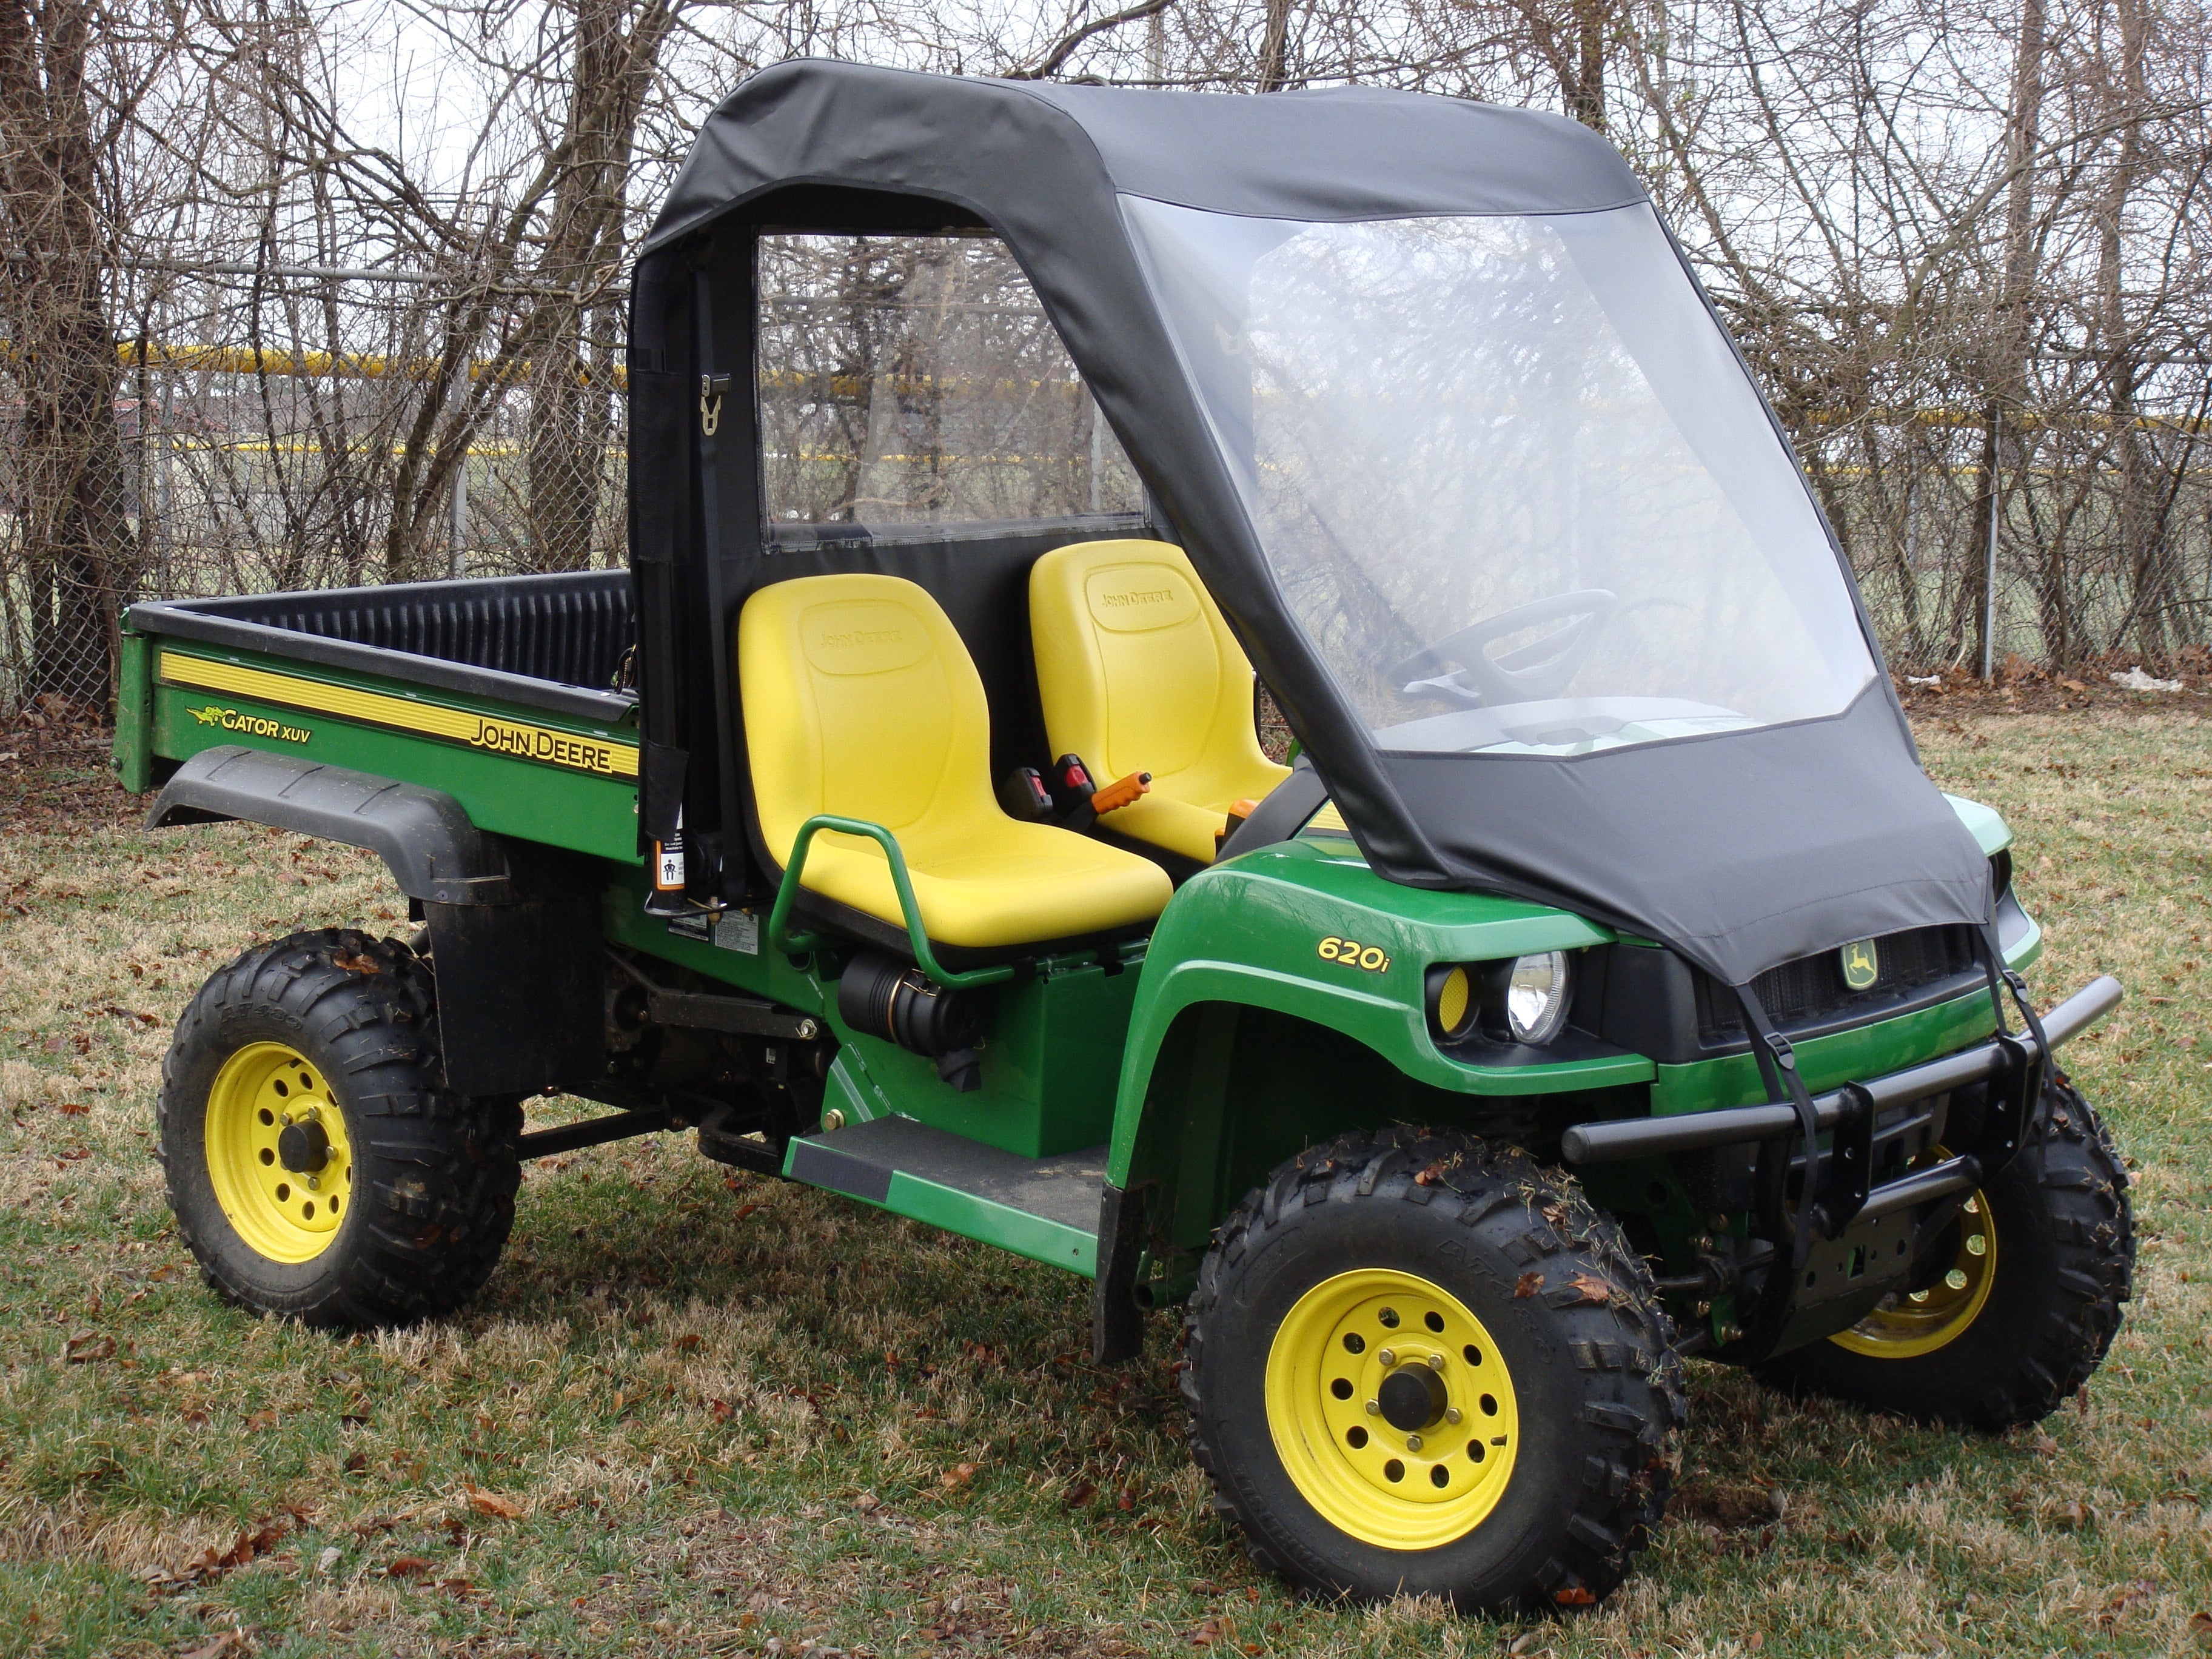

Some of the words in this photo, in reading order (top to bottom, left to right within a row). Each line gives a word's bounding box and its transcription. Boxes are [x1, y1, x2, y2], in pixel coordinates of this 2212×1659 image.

[1102, 594, 1130, 607] JOHN
[1129, 590, 1173, 605] DEERE
[221, 709, 280, 738] GATOR
[281, 726, 310, 743] XUV
[471, 719, 531, 756] JOHN
[537, 731, 611, 771] DEERE
[1318, 937, 1390, 973] 620i
